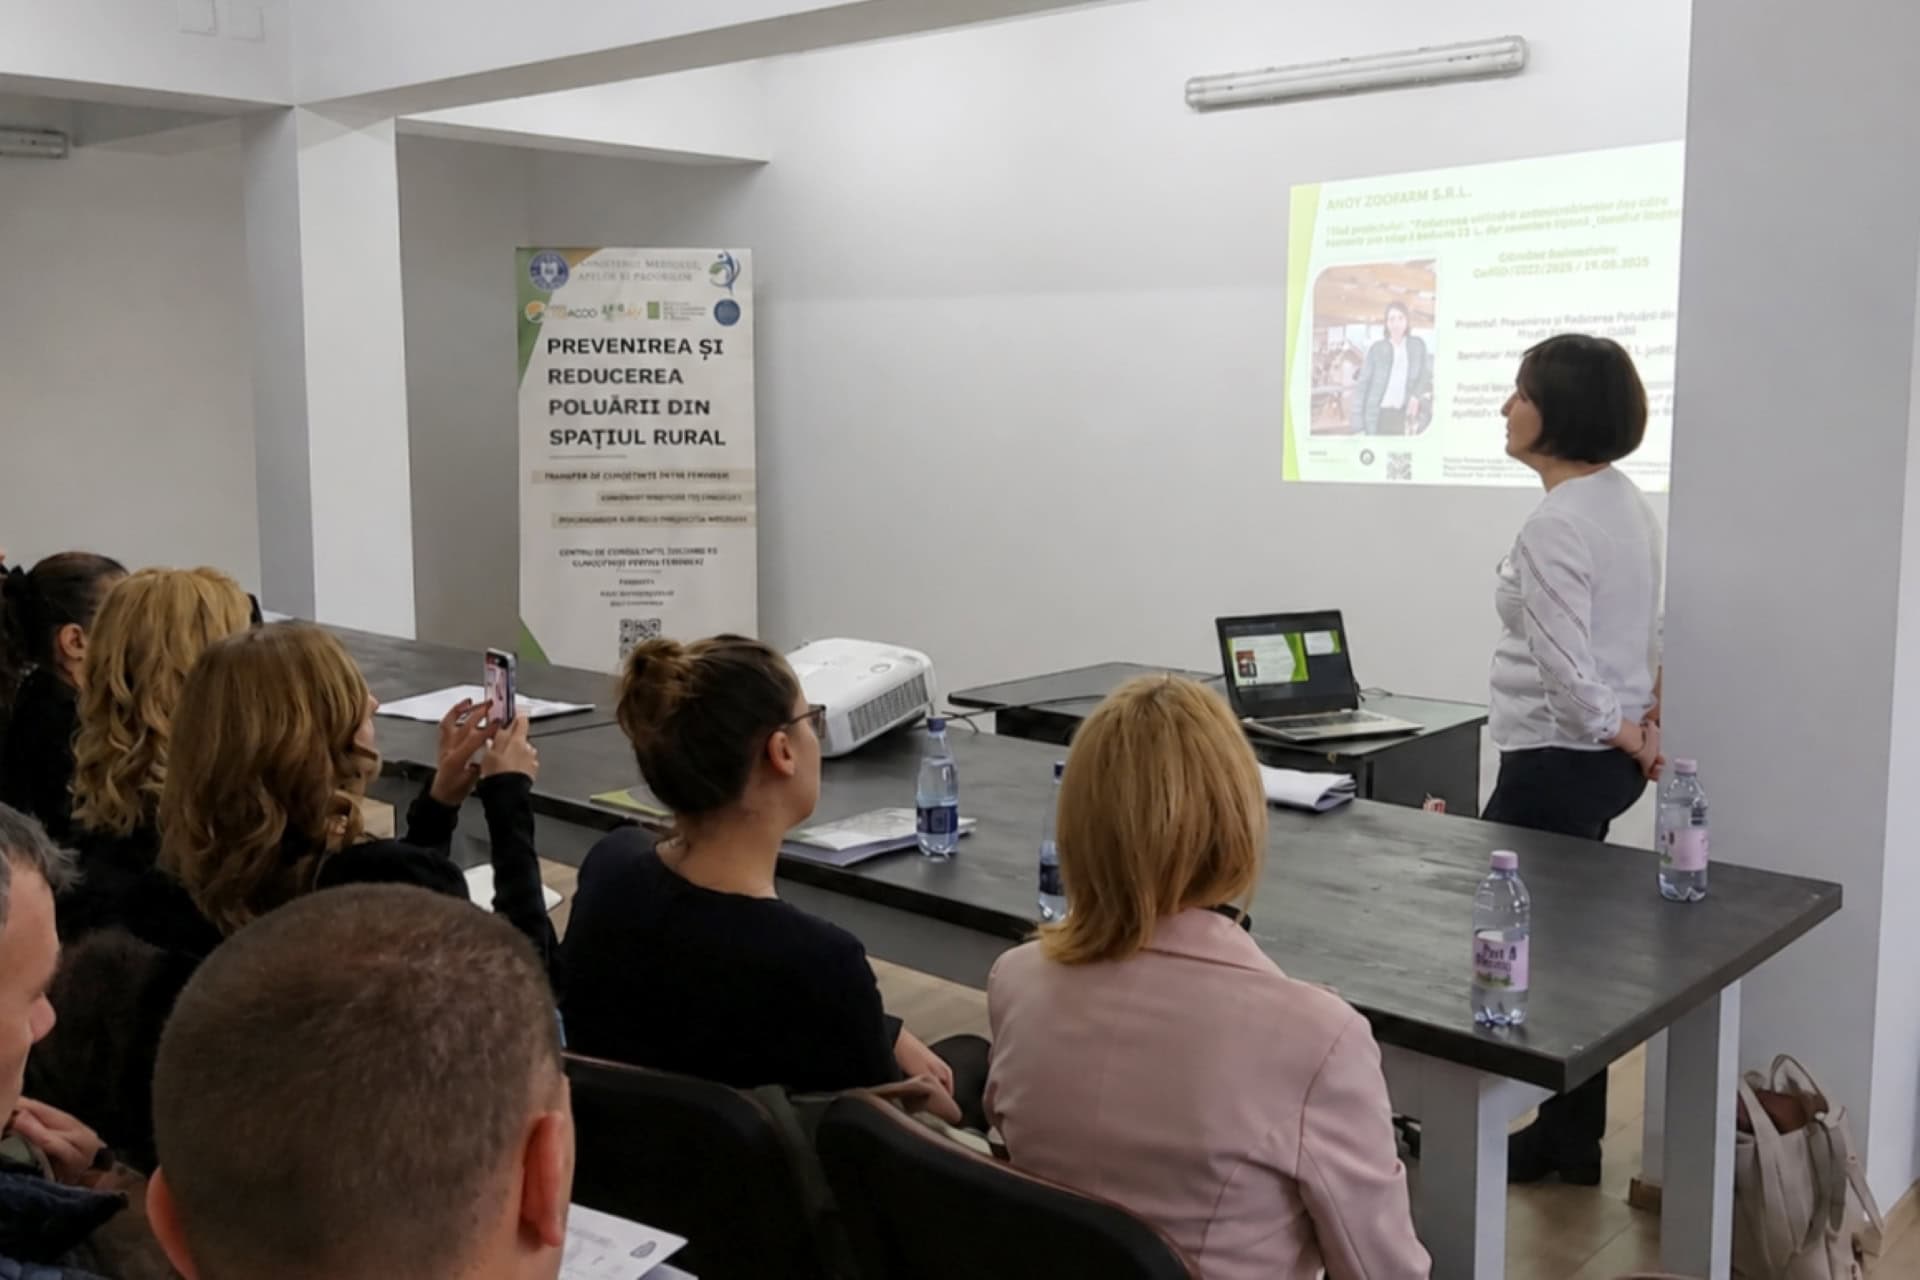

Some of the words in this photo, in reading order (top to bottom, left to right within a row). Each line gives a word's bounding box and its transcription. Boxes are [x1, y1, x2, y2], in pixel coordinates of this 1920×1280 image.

[547, 337, 693, 356] PREVENIREA
[698, 337, 724, 361] ȘI
[548, 367, 684, 385] REDUCEREA
[549, 394, 661, 416] POLUĂRII
[667, 399, 711, 416] DIN
[549, 428, 647, 450] SPAȚIUL
[653, 428, 726, 446] RURAL
